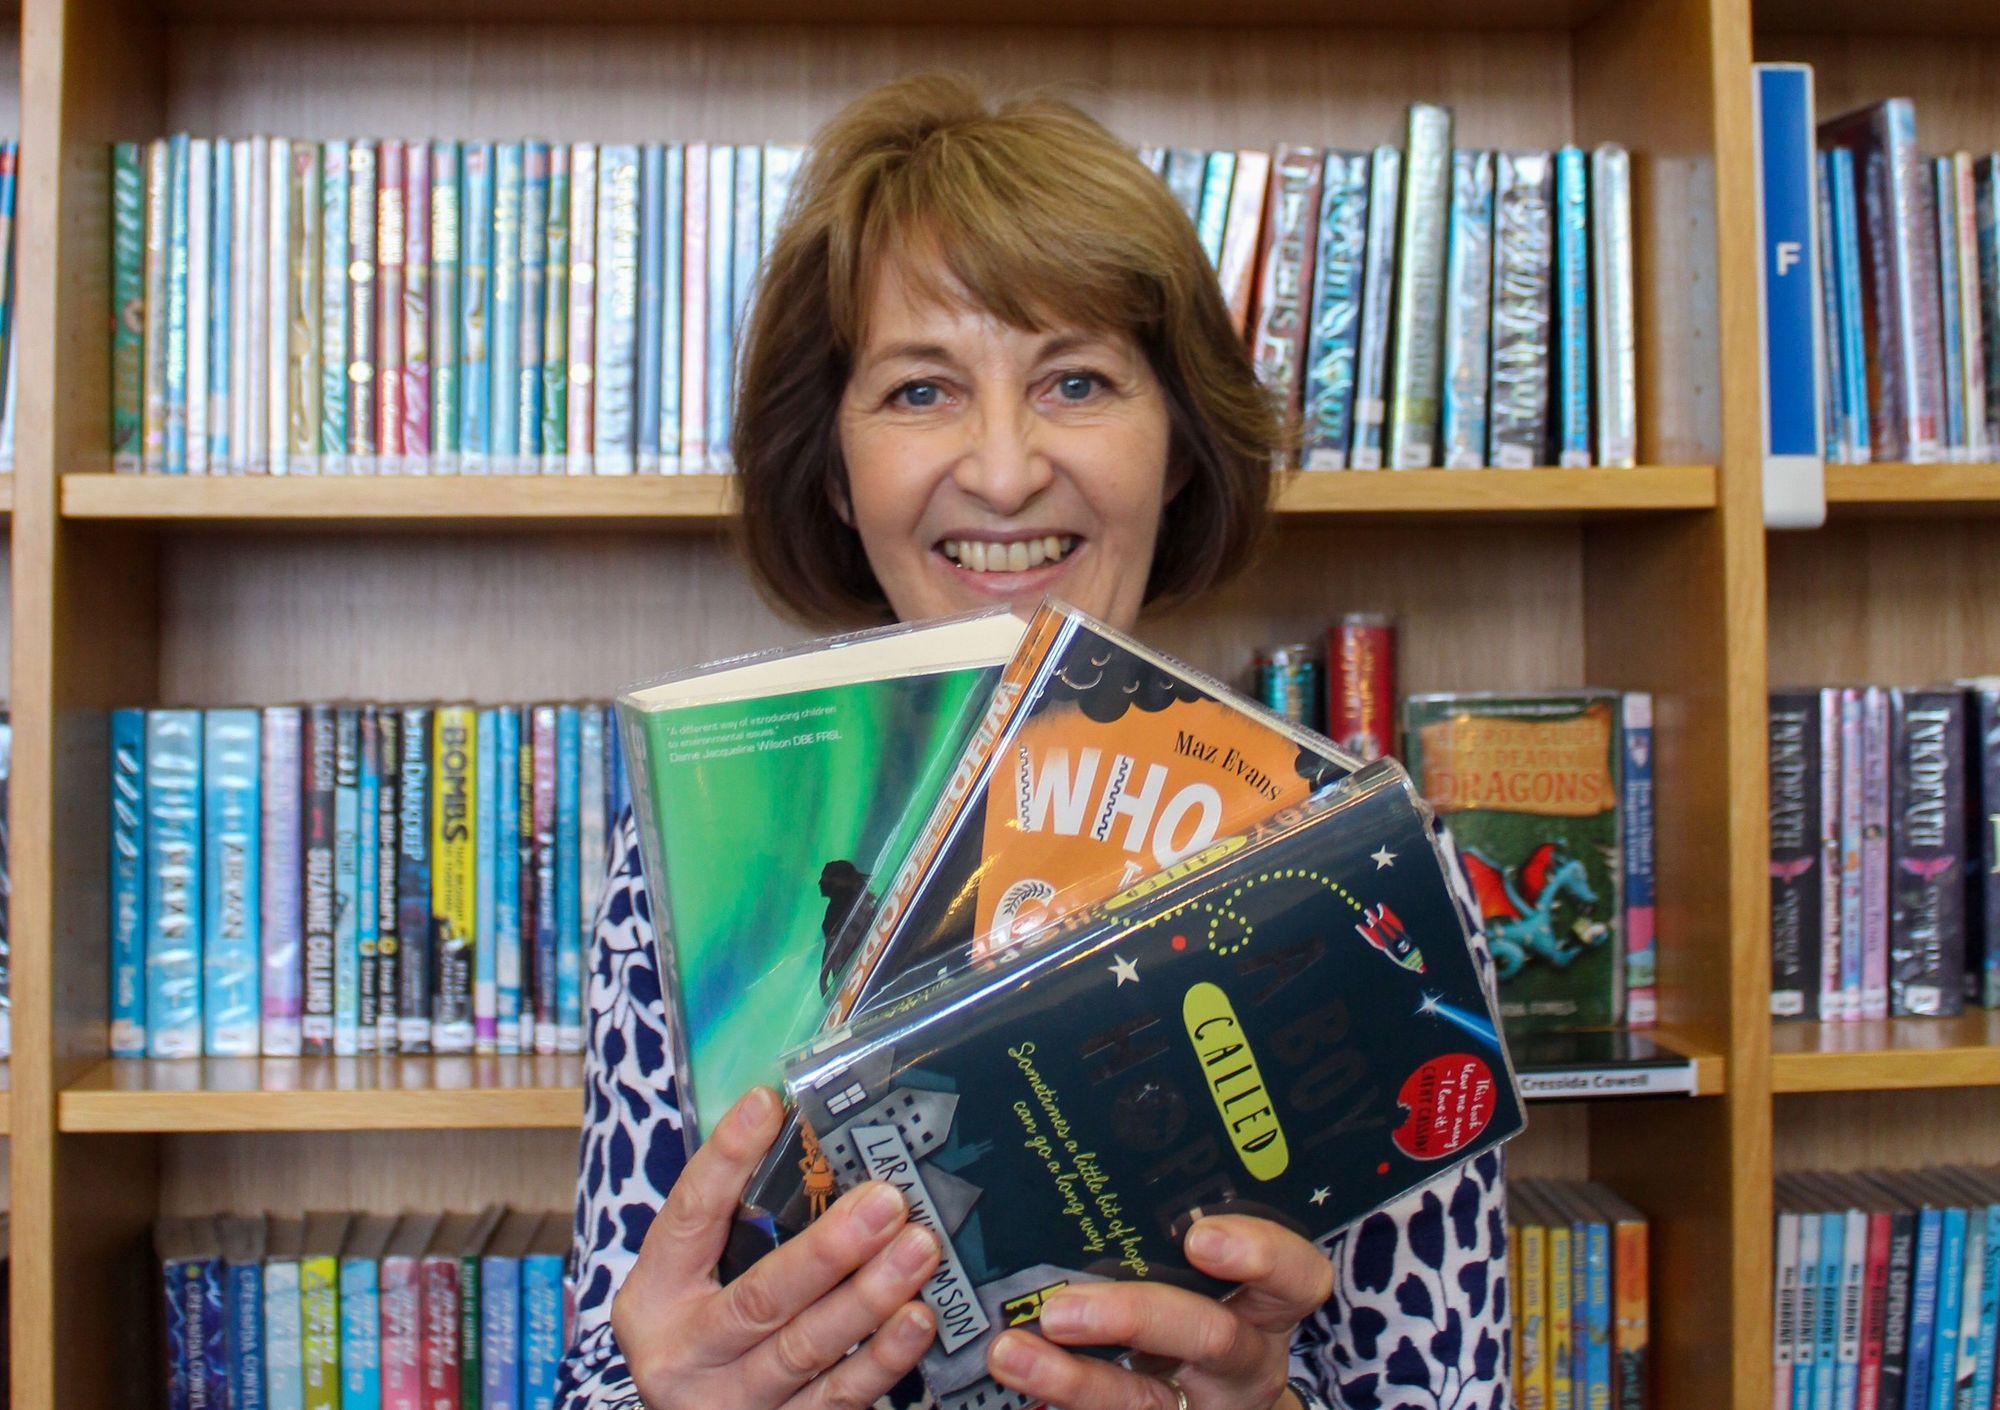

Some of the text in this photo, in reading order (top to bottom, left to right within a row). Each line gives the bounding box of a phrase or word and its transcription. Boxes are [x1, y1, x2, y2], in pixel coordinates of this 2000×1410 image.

[1777, 242, 1801, 277] F
[801, 705, 837, 718] children
[669, 751, 701, 763] Dame
[702, 743, 756, 760] Jacqueline
[756, 739, 791, 751] Wilson
[793, 732, 814, 747] DBE
[1174, 730, 1283, 801] Maz Evans
[440, 727, 469, 844] BOMBS
[1015, 741, 1224, 873] WHO
[1435, 771, 1601, 804] DRAGONS
[307, 935, 333, 1013] COLLINS
[1194, 1016, 1278, 1153] CALLED
[1436, 1088, 1453, 1115] love
[1456, 1094, 1467, 1113] me
[1468, 1078, 1491, 1131] This book
[1520, 1073, 1650, 1091] Cressida Cowell
[1007, 1041, 1150, 1277] Sometimes a little bit of hope
[1443, 1116, 1463, 1149] away
[1012, 1100, 1107, 1252] can go a long way
[1885, 1234, 1911, 1355] THE DEFENDER
